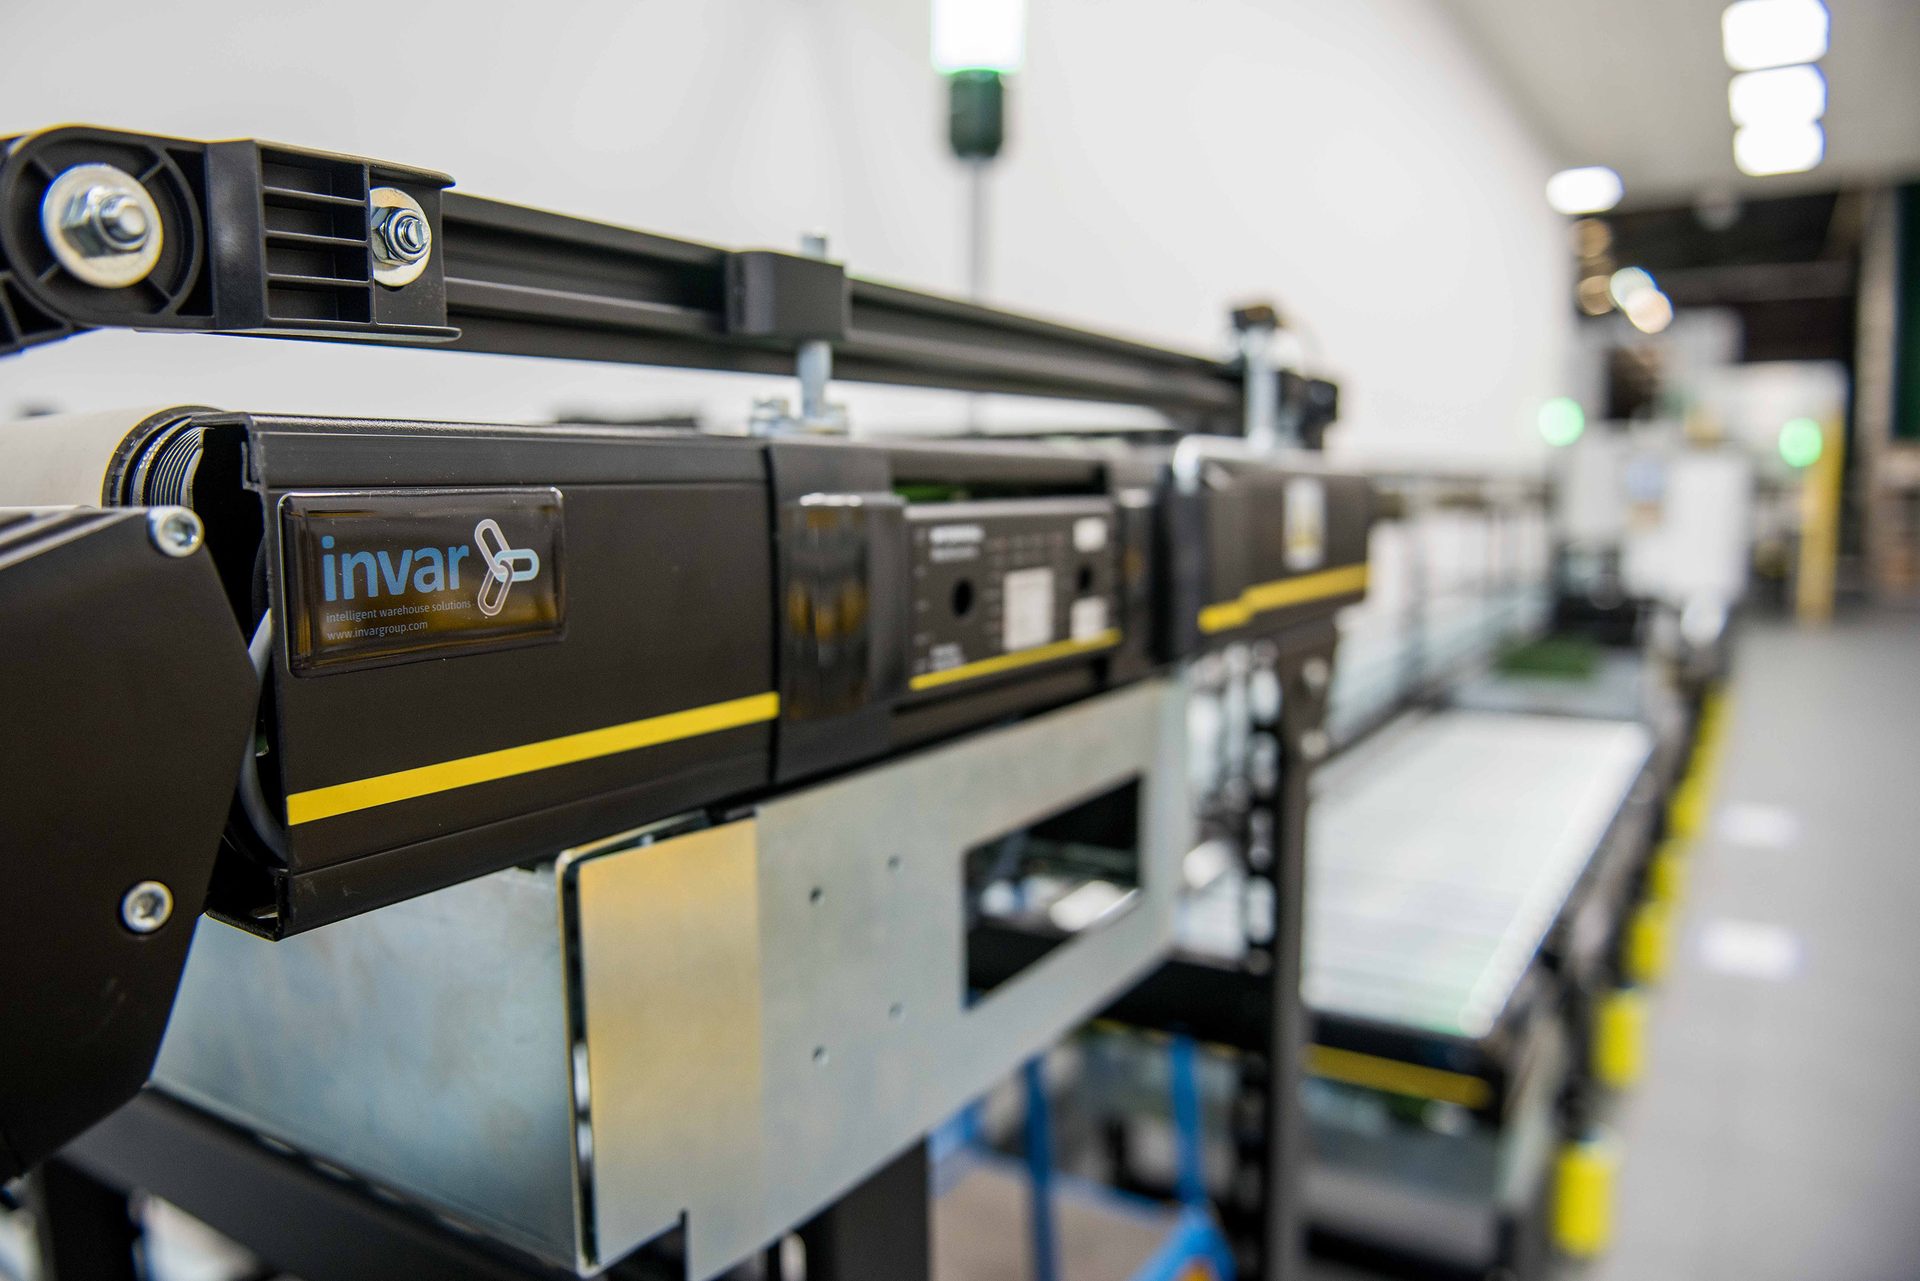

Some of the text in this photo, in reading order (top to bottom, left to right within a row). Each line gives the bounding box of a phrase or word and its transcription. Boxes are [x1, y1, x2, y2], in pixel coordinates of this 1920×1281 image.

[322, 535, 470, 602] invar
[326, 600, 472, 623] intelligent warehouse solutions
[327, 621, 428, 641] www.invargroup.com
